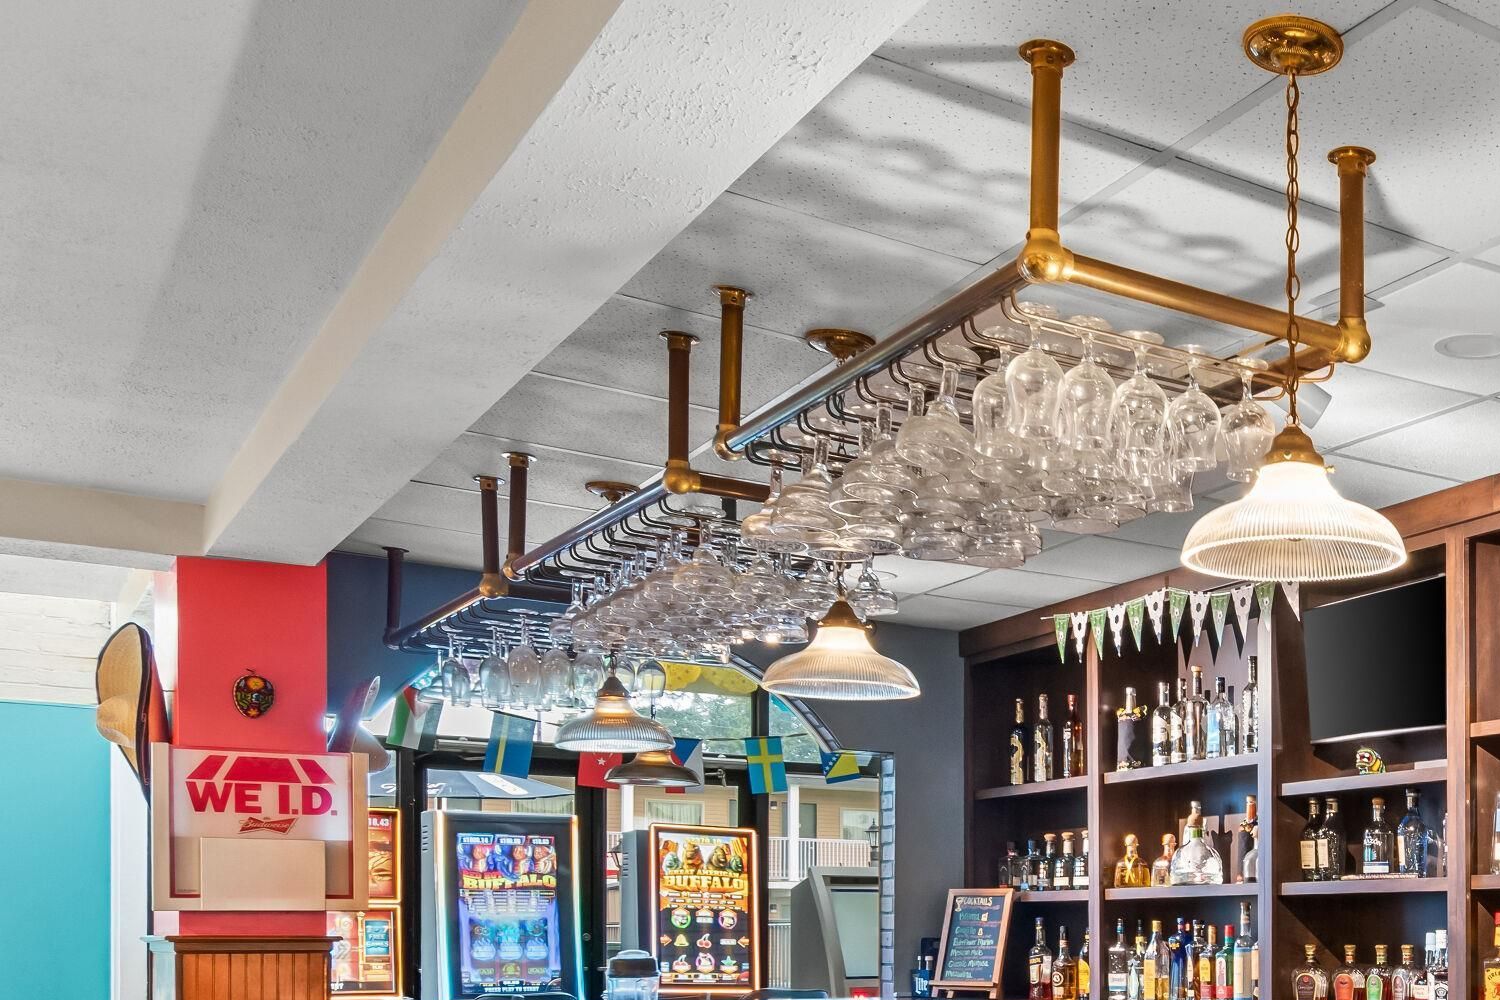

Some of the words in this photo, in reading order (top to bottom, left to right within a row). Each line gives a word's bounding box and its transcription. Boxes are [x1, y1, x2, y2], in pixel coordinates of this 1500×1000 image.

[186, 781, 262, 813] WE
[278, 784, 338, 816] I.D.
[663, 876, 744, 888] BUFFALO
[962, 897, 993, 906] COCKTAILS
[915, 977, 928, 994] Lite
